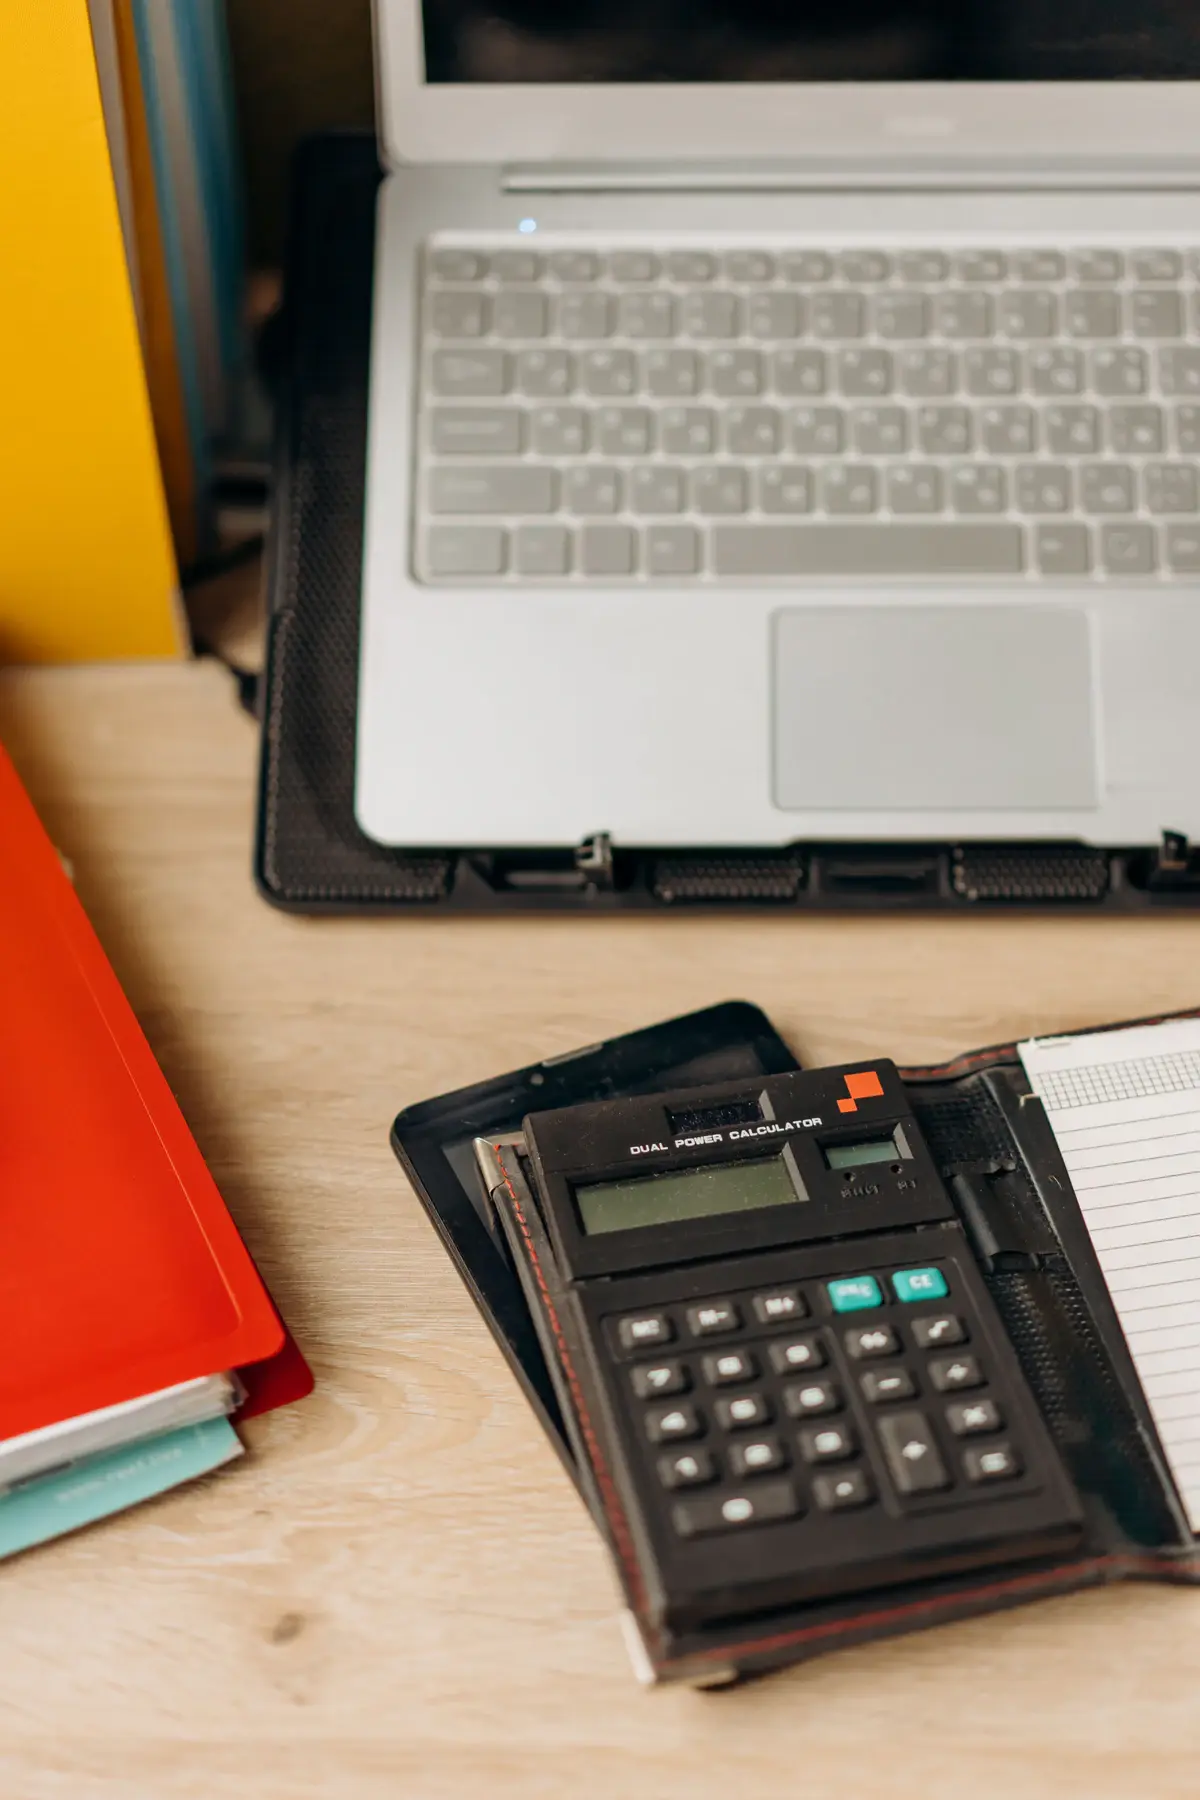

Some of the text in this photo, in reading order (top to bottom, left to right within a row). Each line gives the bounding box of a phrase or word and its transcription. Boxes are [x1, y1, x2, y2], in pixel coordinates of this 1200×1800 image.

[630, 1116, 822, 1155] DUAL POWER CALCULATOR
[909, 1274, 932, 1290] CE
